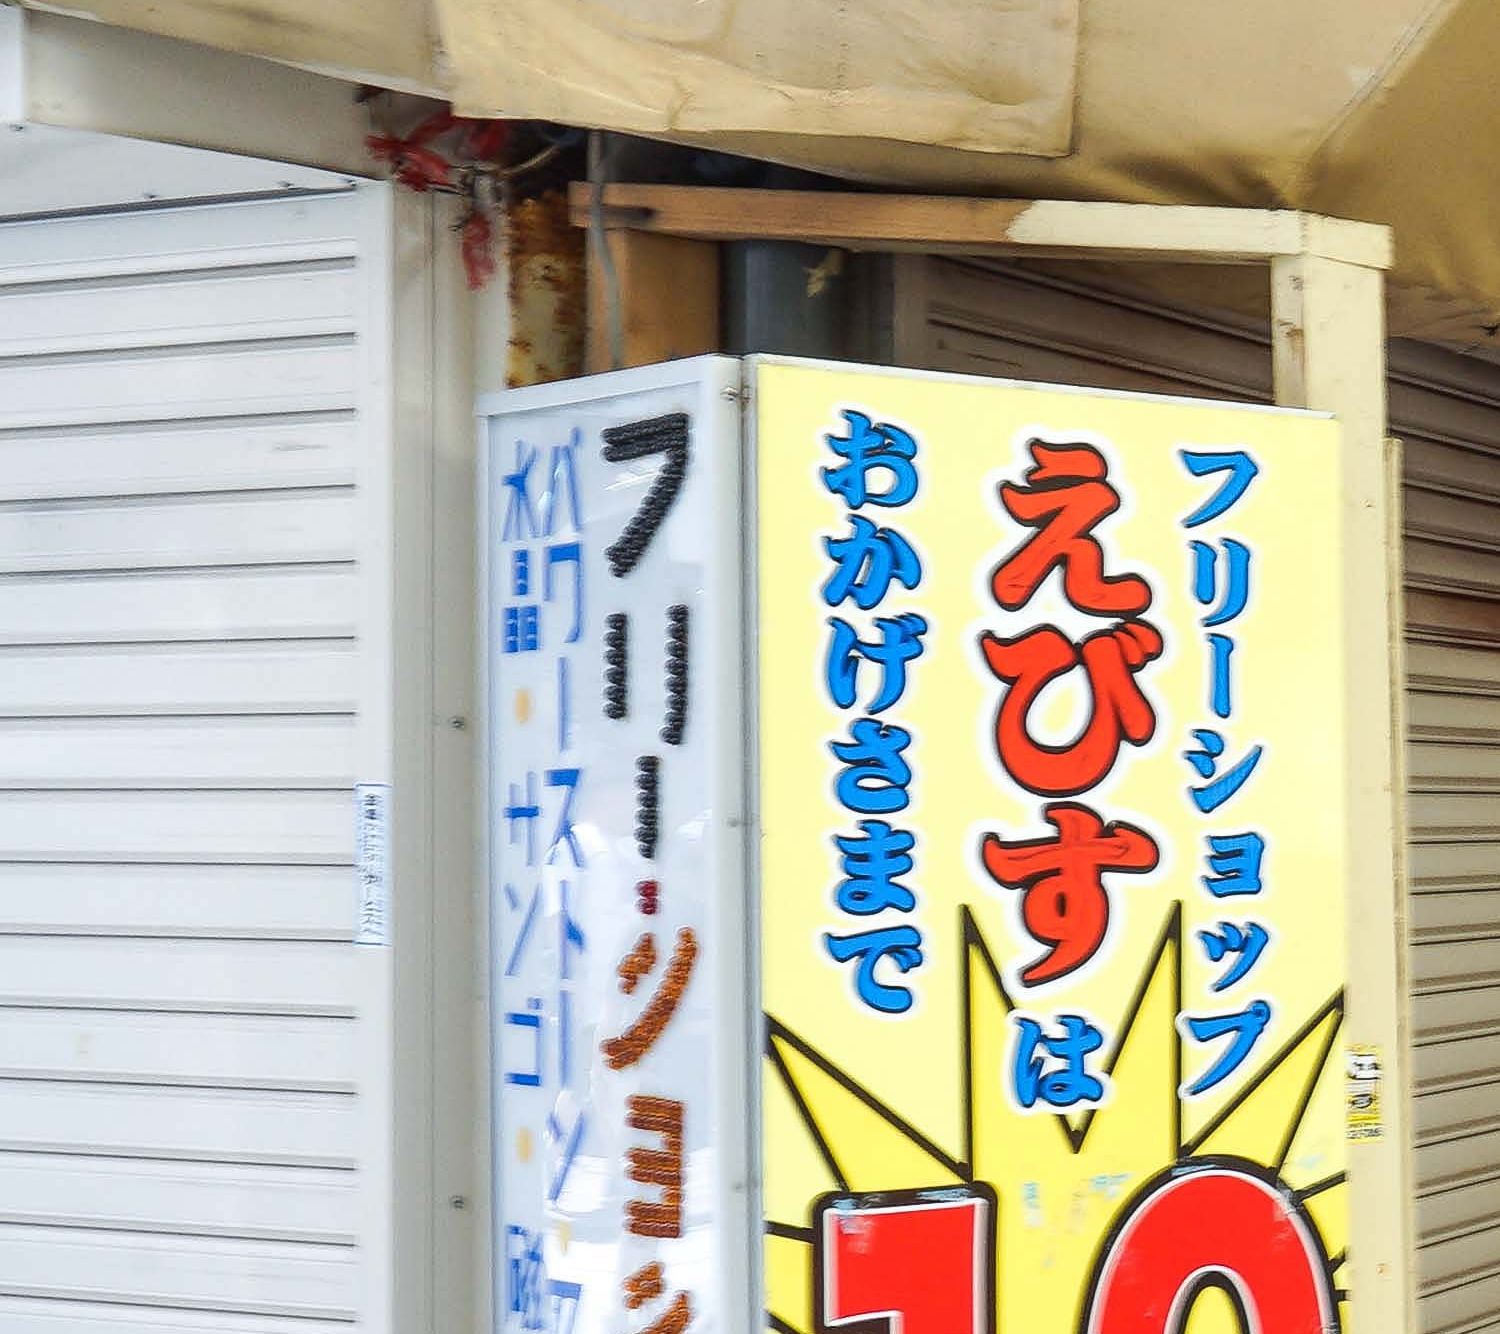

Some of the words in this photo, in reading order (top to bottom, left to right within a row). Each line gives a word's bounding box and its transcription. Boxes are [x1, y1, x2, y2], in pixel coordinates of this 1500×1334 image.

[819, 408, 928, 1015] おかげさまで
[1179, 448, 1272, 1098] フリーショップ
